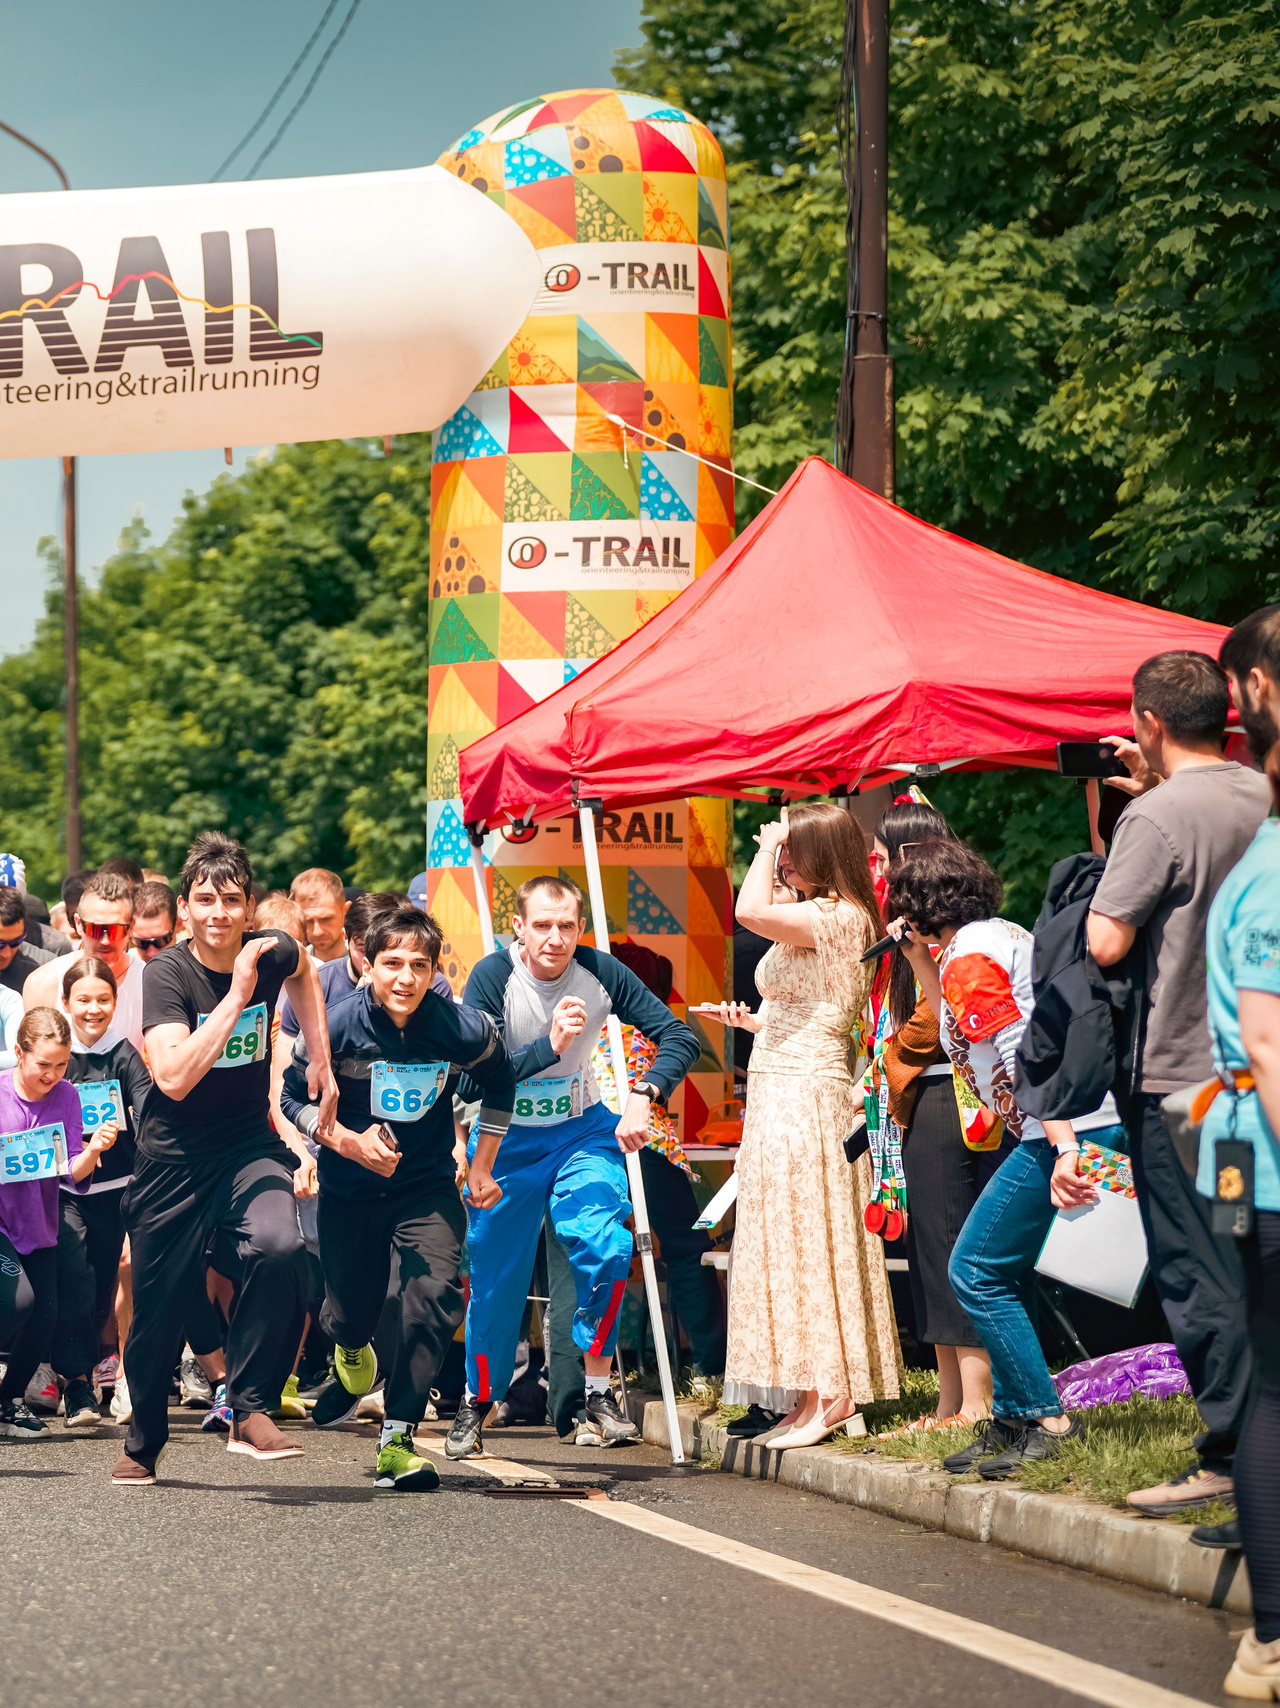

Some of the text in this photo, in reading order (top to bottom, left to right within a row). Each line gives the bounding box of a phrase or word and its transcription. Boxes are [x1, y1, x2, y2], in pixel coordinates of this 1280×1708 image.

[218, 1031, 259, 1060] 69
[381, 1088, 438, 1113] 664
[515, 1095, 572, 1117] 838
[81, 1102, 118, 1126] 62
[5, 1147, 55, 1176] 597
